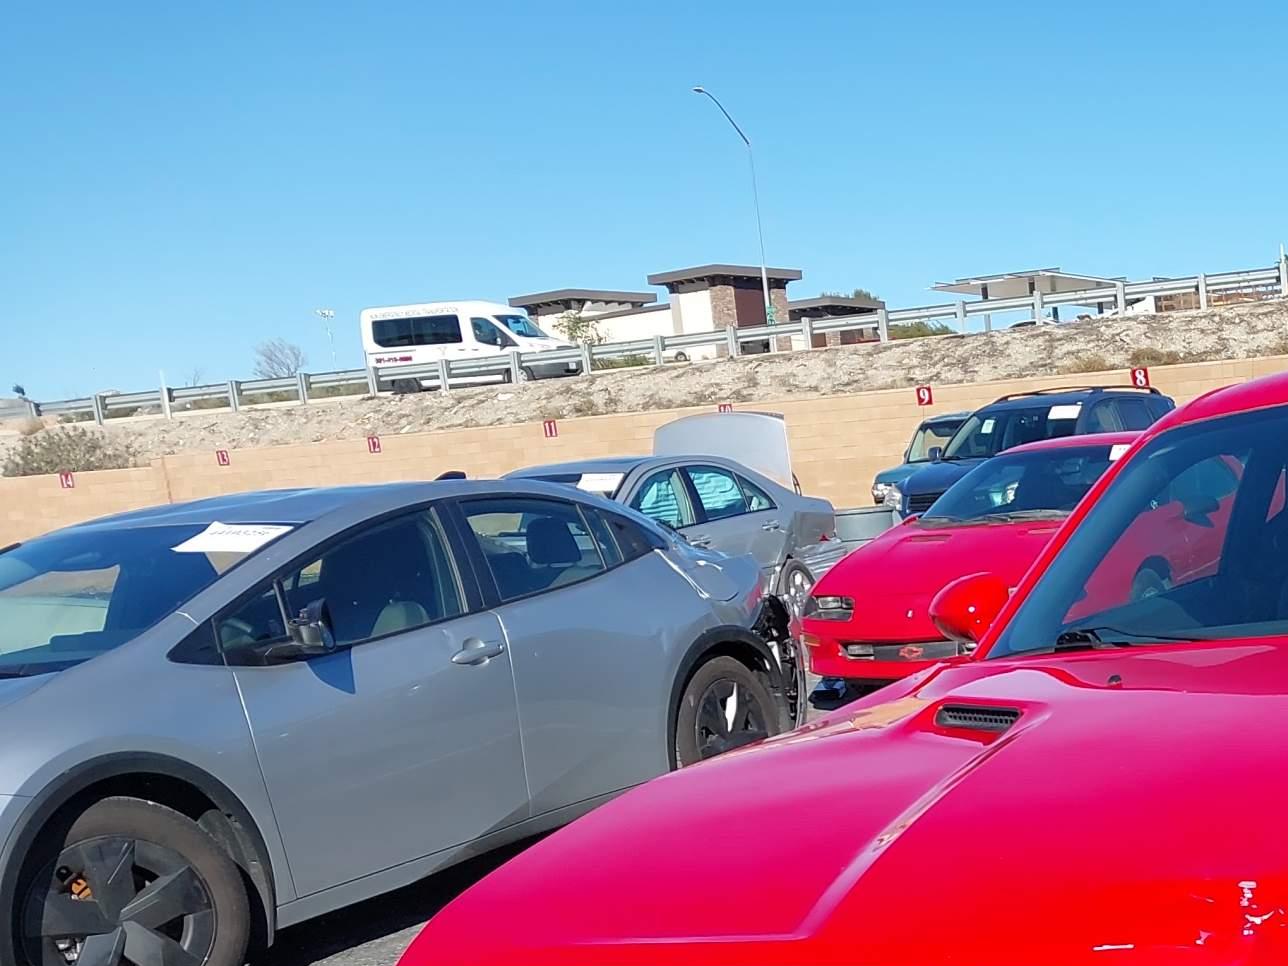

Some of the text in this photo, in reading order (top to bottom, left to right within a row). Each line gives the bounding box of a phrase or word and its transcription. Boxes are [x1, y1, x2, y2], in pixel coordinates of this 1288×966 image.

[1134, 369, 1146, 386] 8
[919, 388, 929, 405] 9
[544, 421, 557, 437] 11
[368, 438, 380, 452] 12
[218, 452, 228, 465] 13
[61, 474, 73, 488] 14
